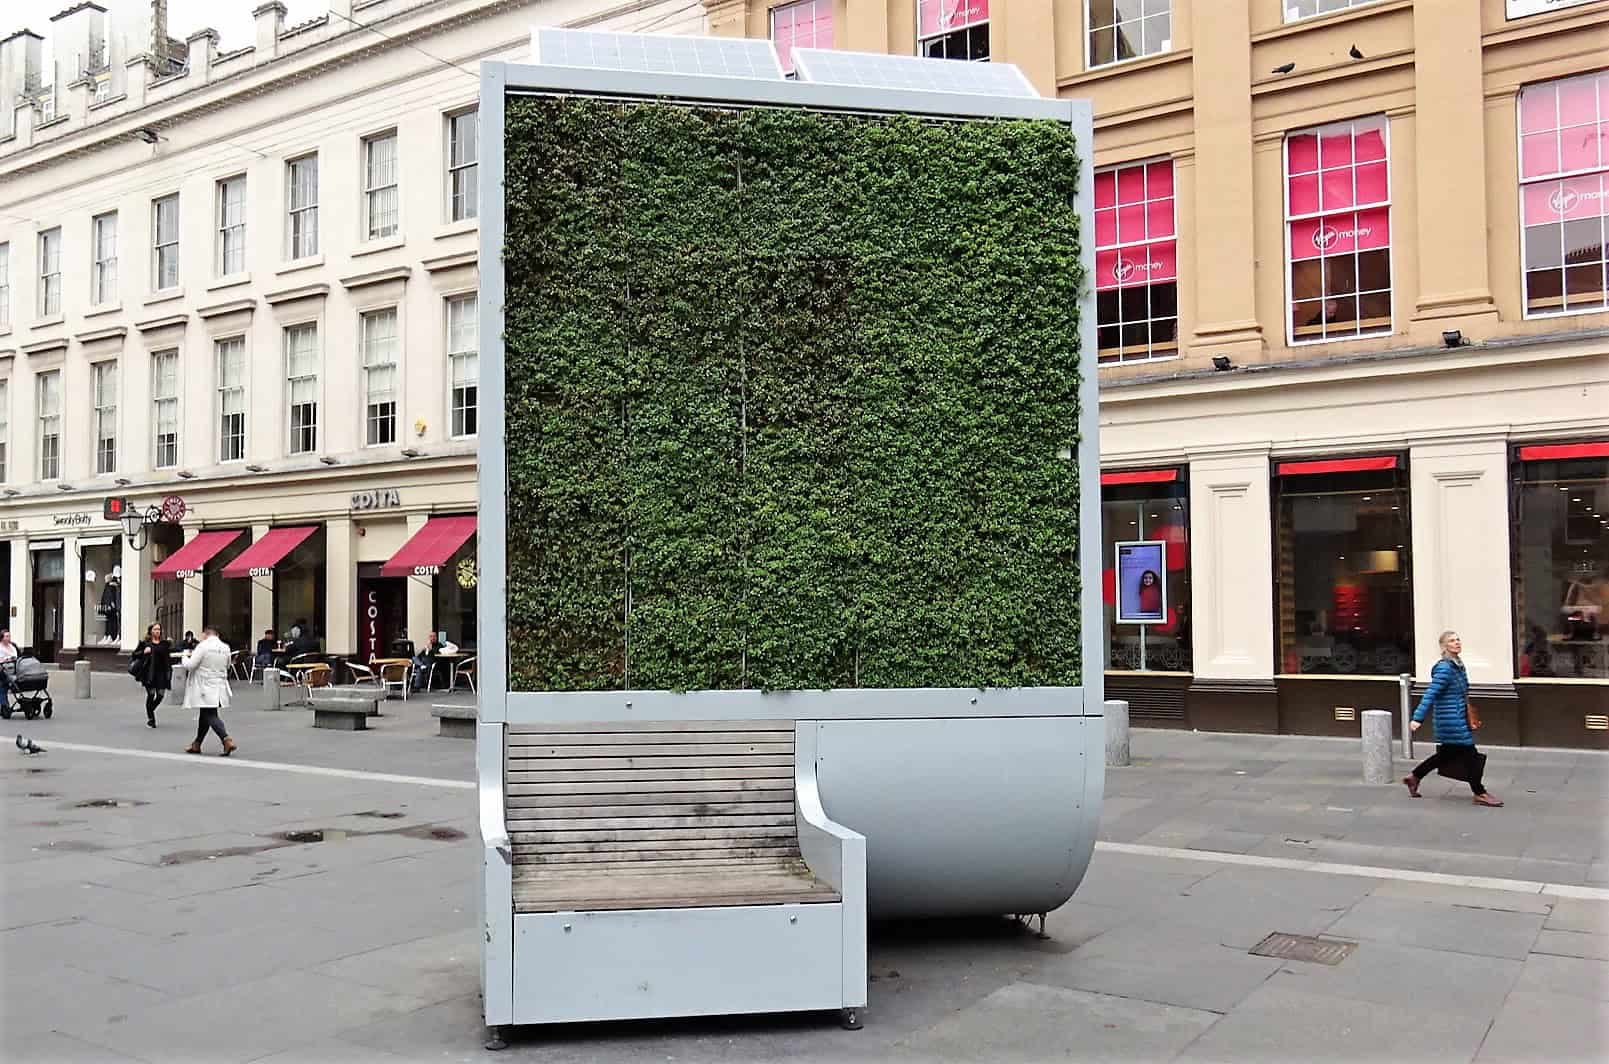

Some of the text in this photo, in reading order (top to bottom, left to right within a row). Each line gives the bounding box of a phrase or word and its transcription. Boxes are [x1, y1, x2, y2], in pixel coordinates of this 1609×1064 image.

[1339, 227, 1371, 239] money
[1135, 262, 1163, 274] money
[351, 488, 400, 510] COSTA
[176, 569, 194, 578] COSTA
[248, 567, 270, 577] COSTA
[414, 566, 440, 575] COSTA
[368, 591, 378, 665] COSTA
